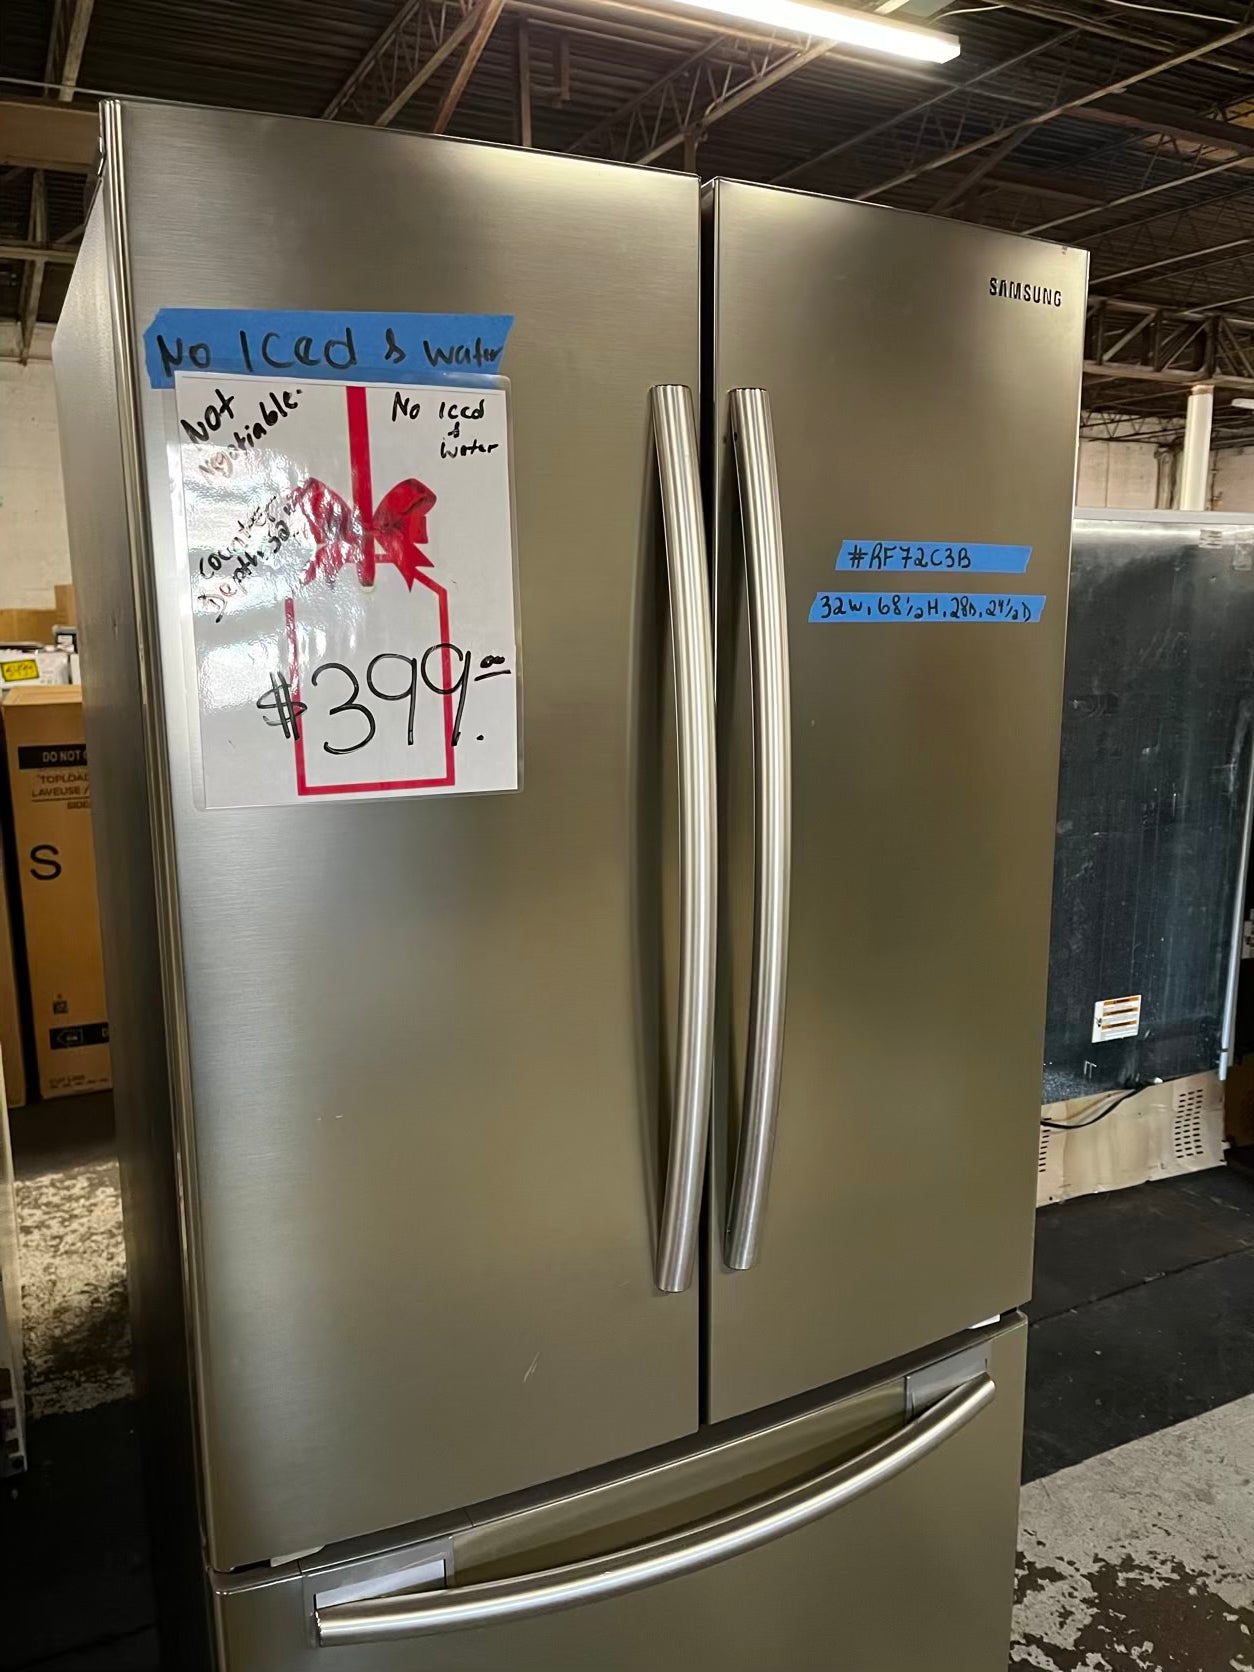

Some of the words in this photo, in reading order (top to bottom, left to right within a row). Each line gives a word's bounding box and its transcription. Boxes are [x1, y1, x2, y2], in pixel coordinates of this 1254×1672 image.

[989, 277, 1062, 307] SAMSUNG
[156, 334, 211, 378] No
[391, 391, 420, 422] No
[42, 751, 58, 763] DO
[60, 749, 81, 761] NOT
[30, 843, 62, 881] S
